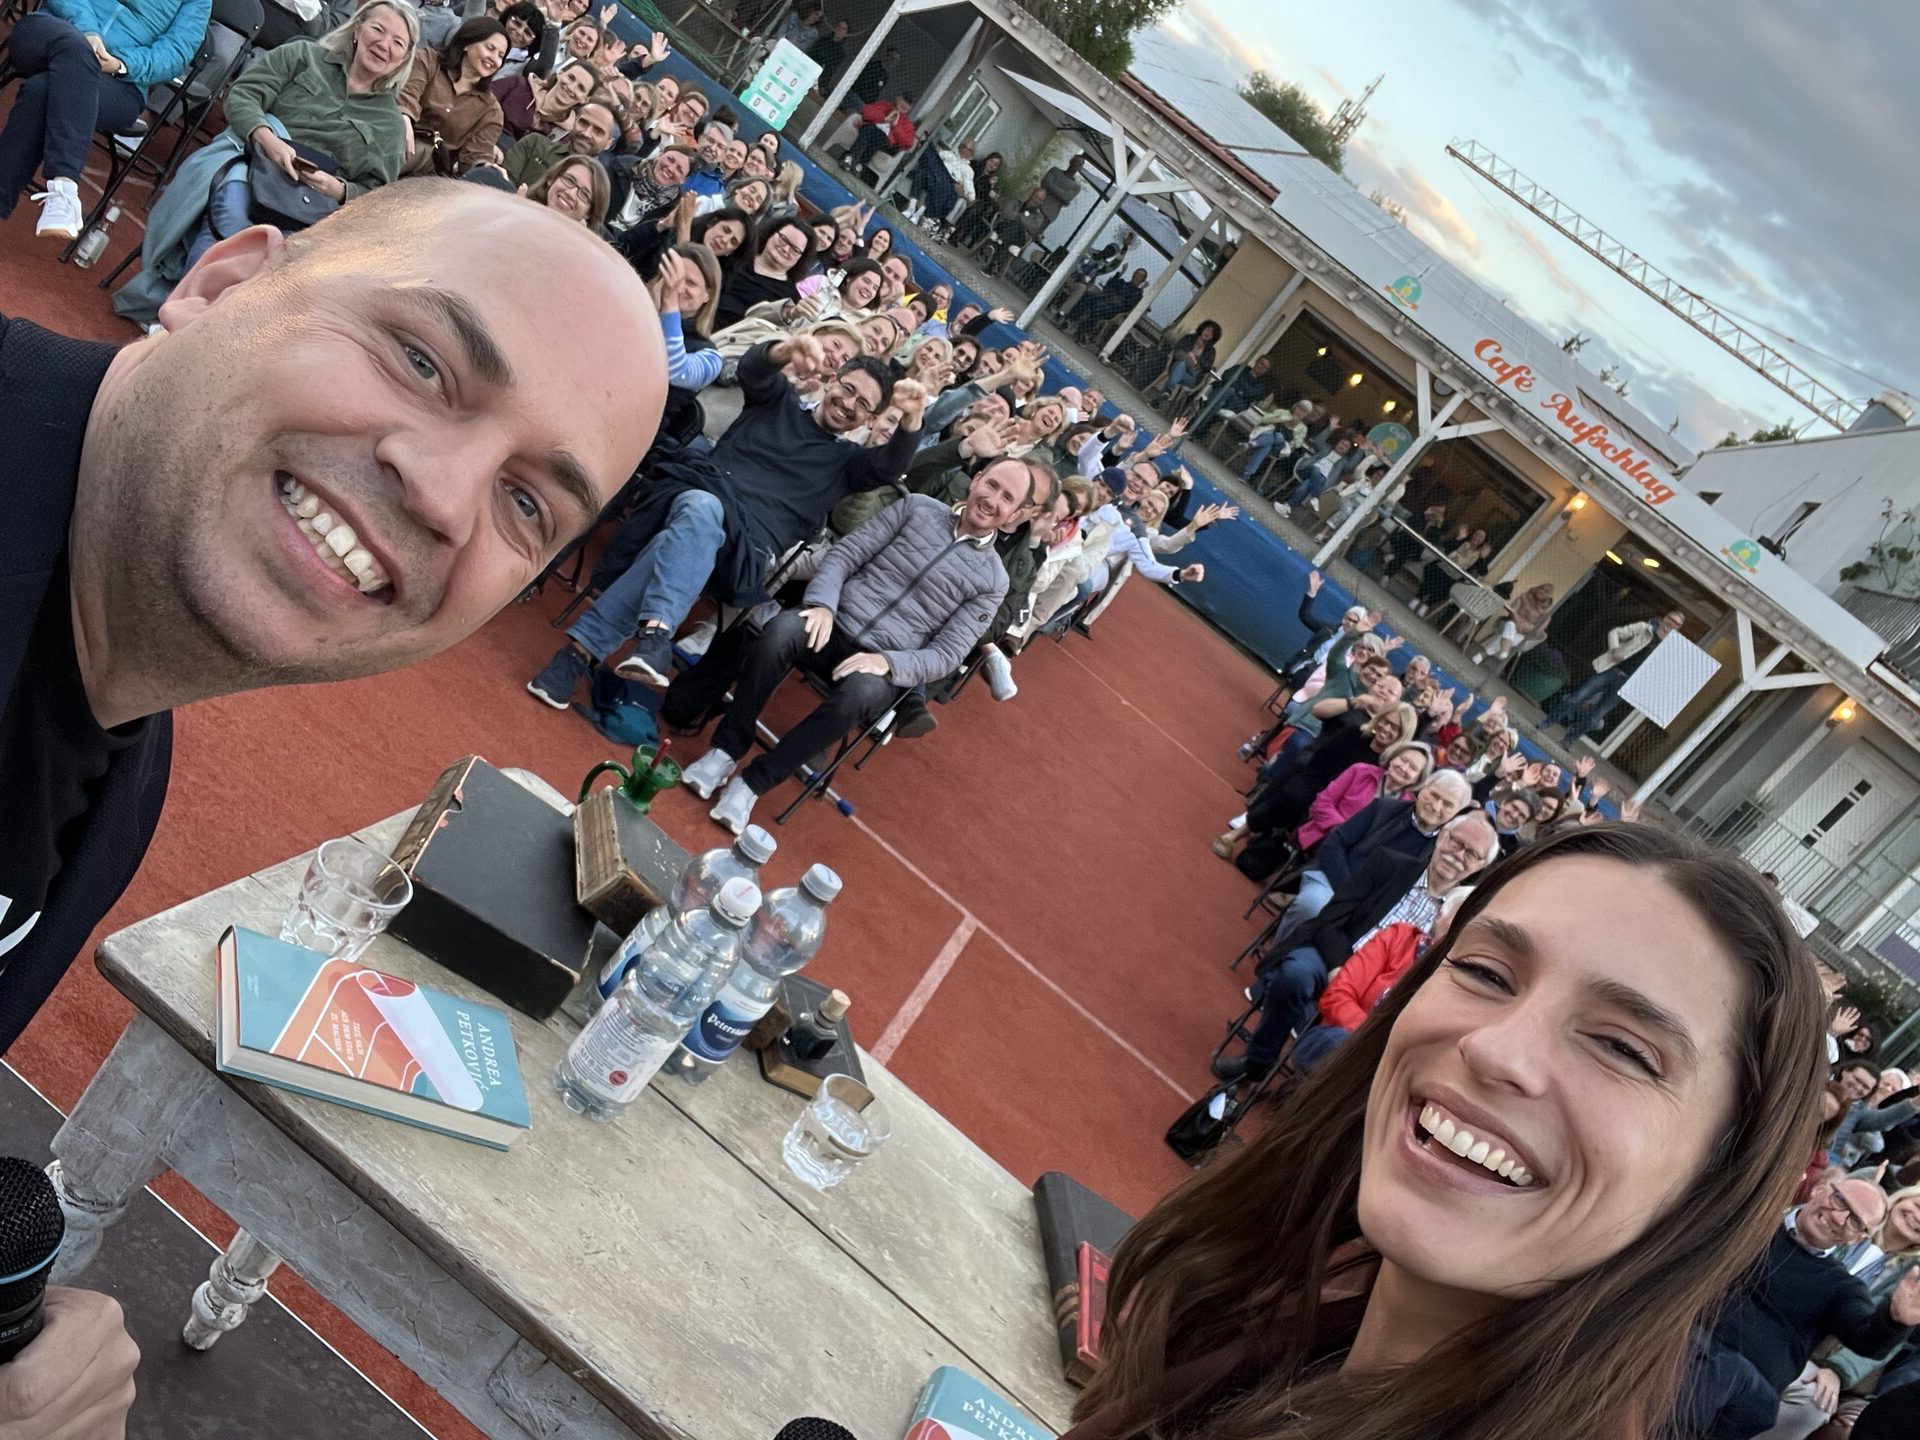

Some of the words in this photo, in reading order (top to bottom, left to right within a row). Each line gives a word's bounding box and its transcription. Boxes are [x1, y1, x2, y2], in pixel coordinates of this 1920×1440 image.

[1474, 338, 1536, 393] Café
[1540, 393, 1676, 505] Aufschlag
[477, 1022, 502, 1086] ANDREA
[962, 1402, 1019, 1440] PETK
